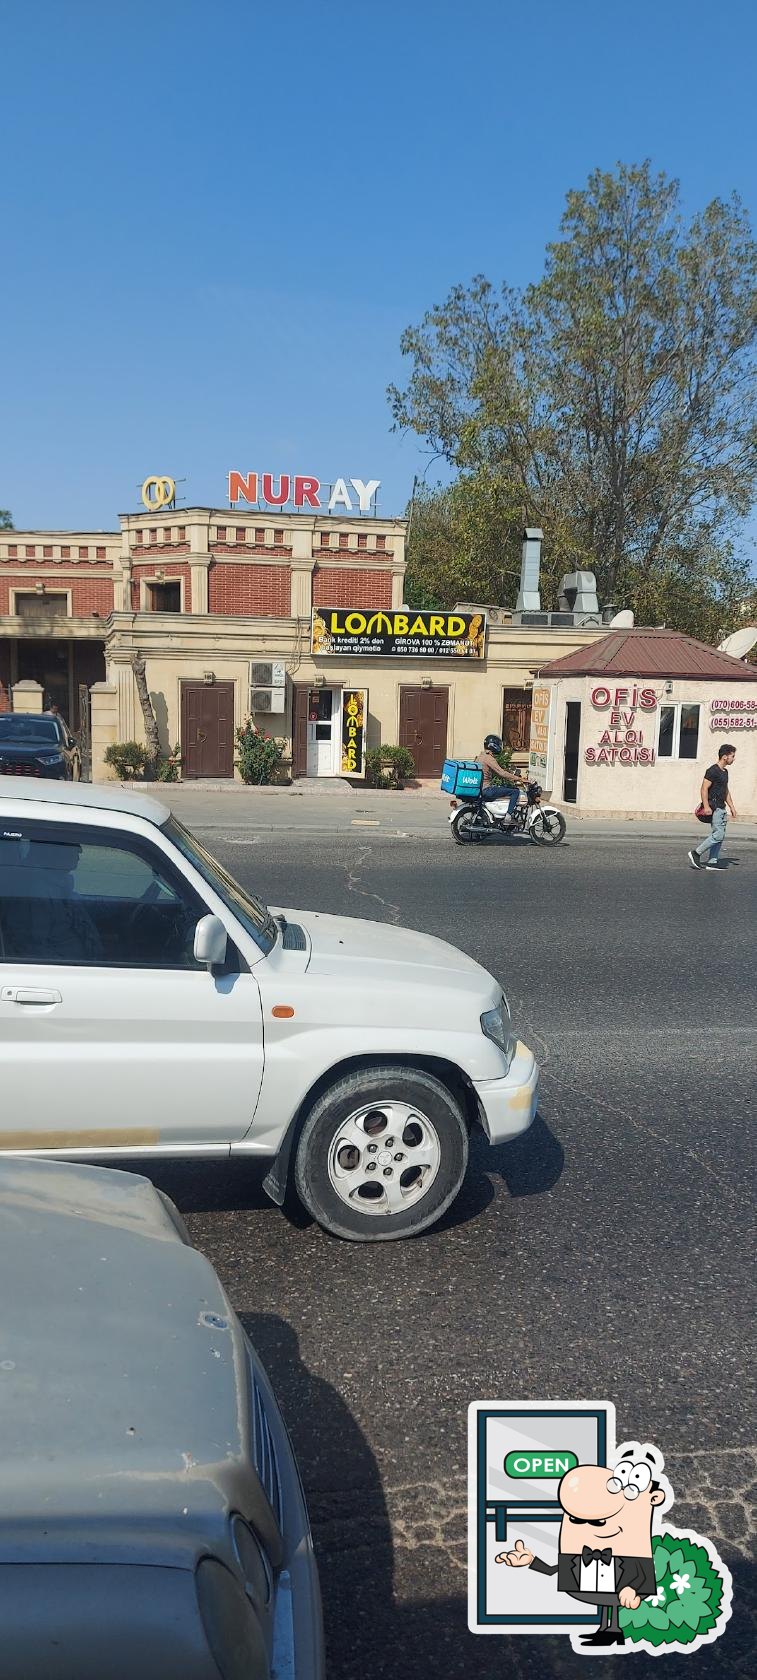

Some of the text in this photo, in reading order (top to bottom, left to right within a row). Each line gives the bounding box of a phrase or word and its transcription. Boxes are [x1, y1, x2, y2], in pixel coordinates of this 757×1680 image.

[228, 470, 381, 511] NURAY
[395, 638, 420, 646] GİROVA
[591, 683, 657, 708] OFİS
[610, 711, 635, 725] EV
[600, 730, 643, 744] ALQI
[585, 747, 655, 762] SATQISI
[462, 776, 478, 784] Wolt
